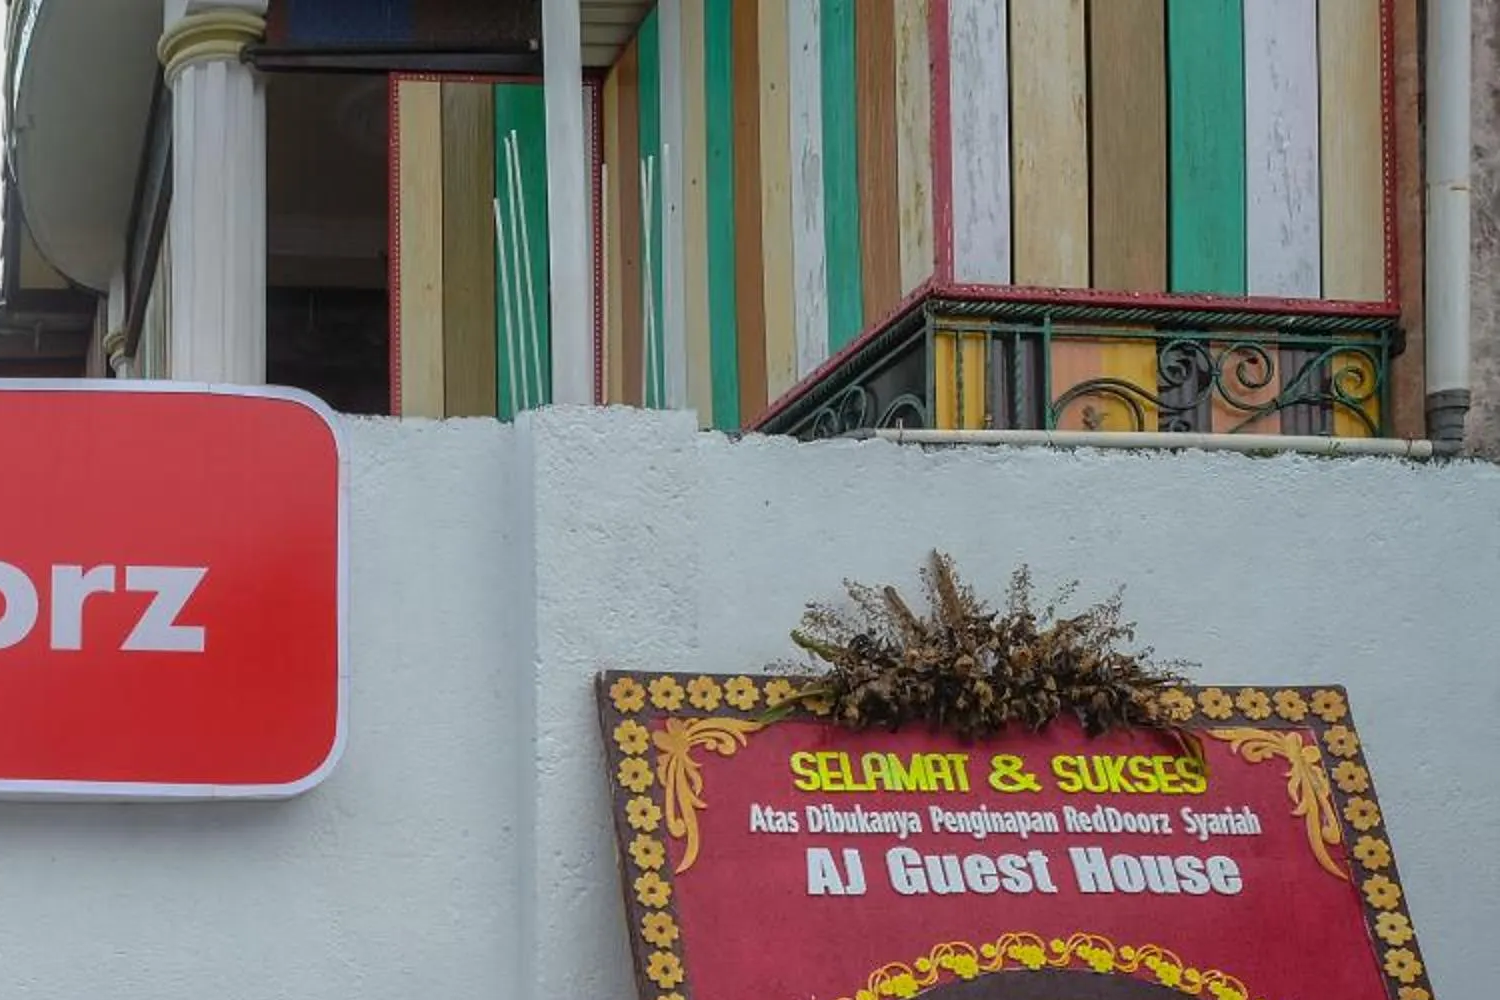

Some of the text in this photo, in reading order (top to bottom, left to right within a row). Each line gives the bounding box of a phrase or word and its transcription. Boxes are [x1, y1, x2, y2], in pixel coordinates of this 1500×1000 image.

[789, 751, 1208, 794] SELAMAT & SUKSES
[750, 803, 1263, 841] Atas Dibukanya Penginapan RedDoorz Syariah
[806, 846, 1243, 896] AJ Guest House
